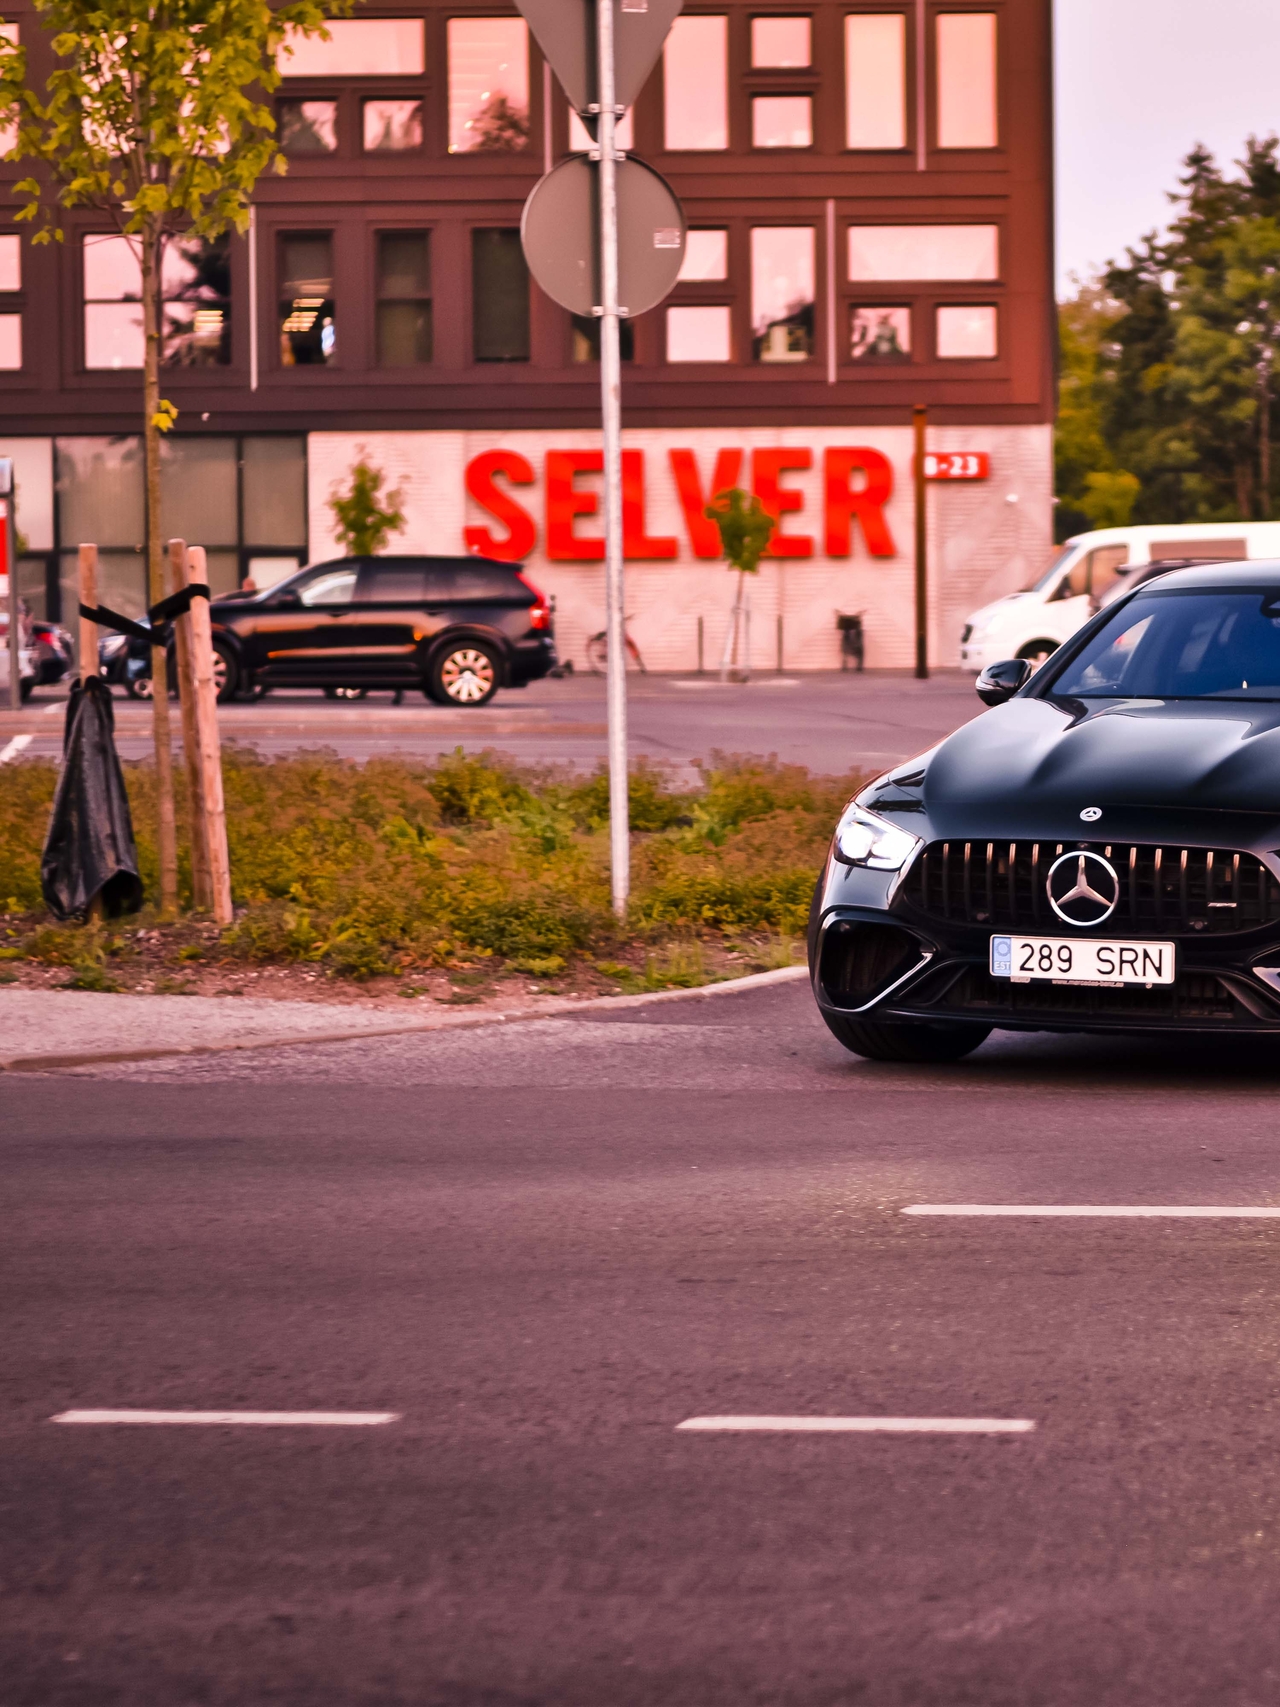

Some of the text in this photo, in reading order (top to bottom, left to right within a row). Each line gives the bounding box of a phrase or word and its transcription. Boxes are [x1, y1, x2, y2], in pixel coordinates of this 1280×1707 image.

[464, 446, 895, 560] SELVER
[994, 961, 1010, 970] EST
[1019, 943, 1163, 976] 289 SRN
